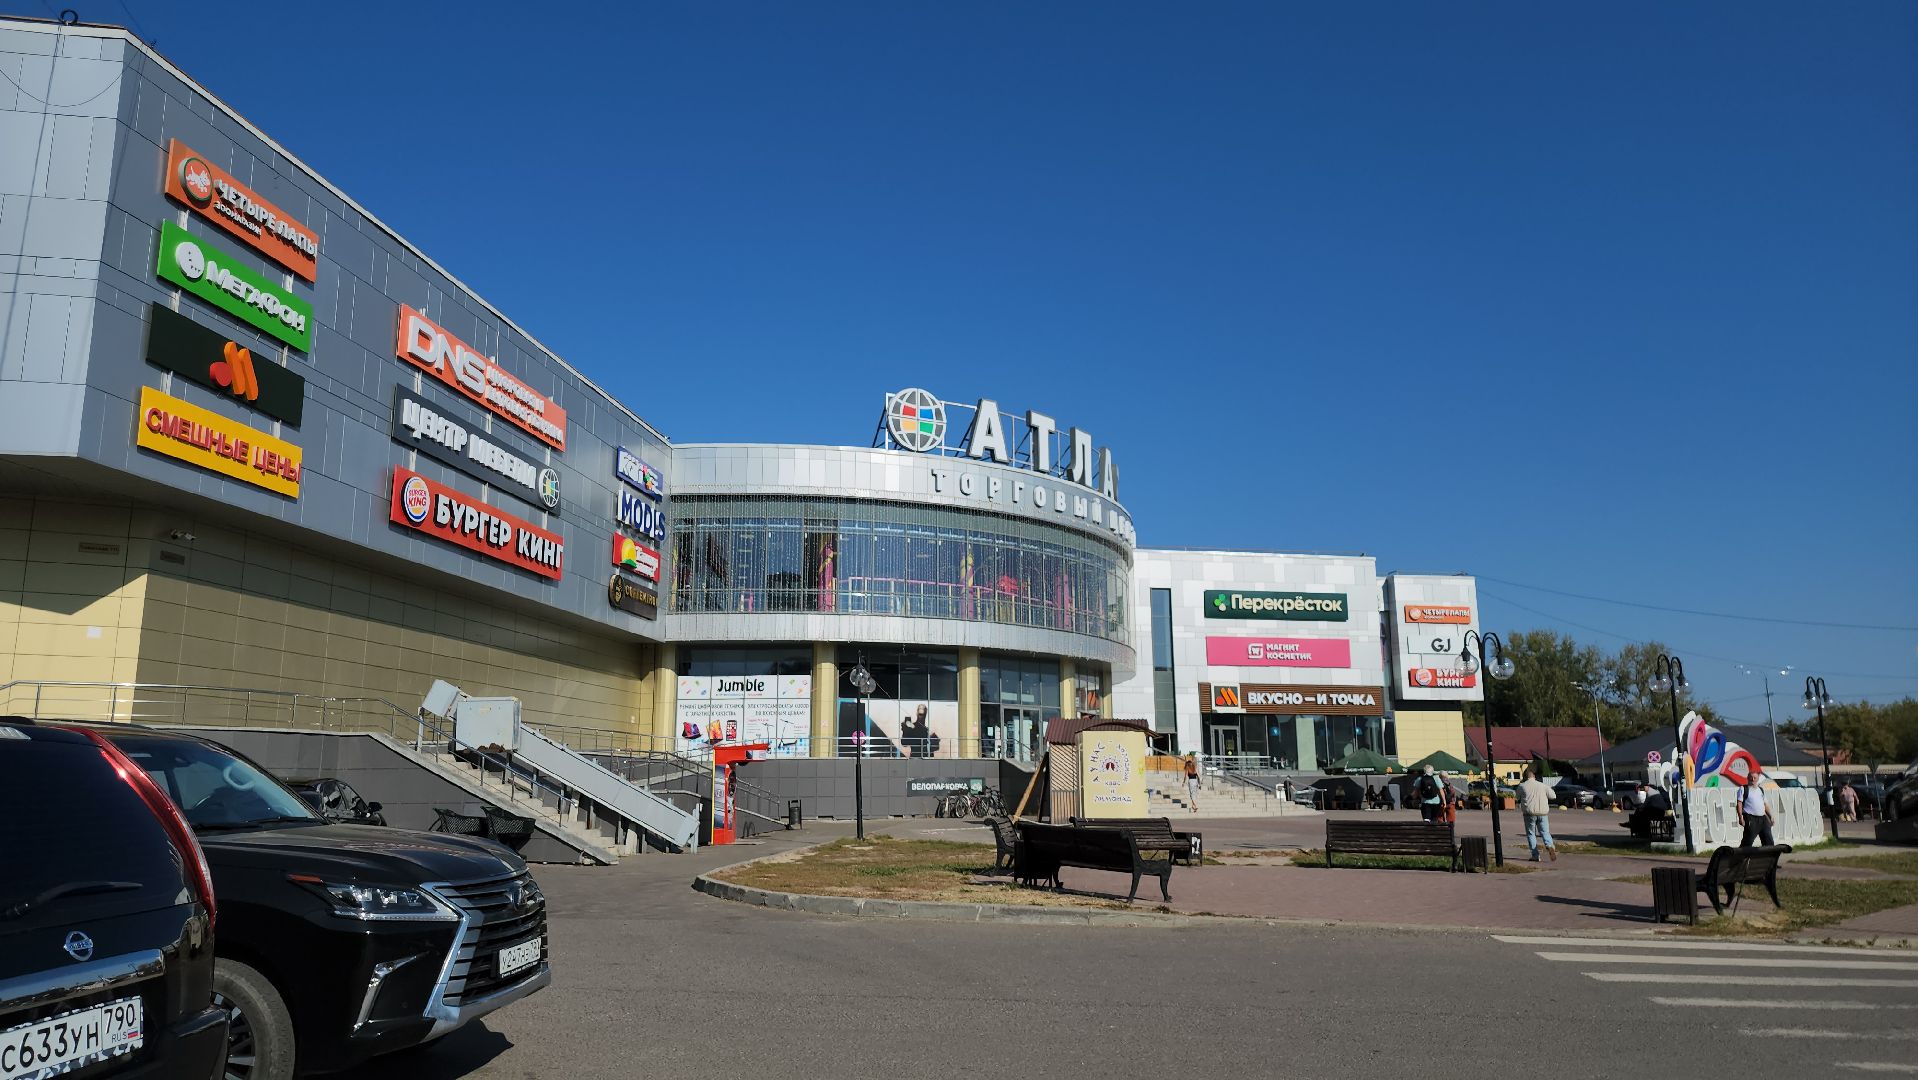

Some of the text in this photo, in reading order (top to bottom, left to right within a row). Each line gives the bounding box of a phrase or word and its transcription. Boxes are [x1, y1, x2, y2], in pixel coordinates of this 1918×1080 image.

[213, 200, 262, 236] ЗООМАГАЗИН
[213, 178, 317, 260] ЧЕТЫРЕ ЛАПЫ
[205, 260, 305, 333] МЕГАФОН
[406, 315, 487, 394] DNS
[145, 407, 300, 484] СМЕШНЫЕ ЦЕНЫ
[402, 398, 537, 490] ЦЕНТР МЕБЕЛИ
[967, 398, 1119, 502] АТЛА
[408, 497, 427, 507] KING
[619, 490, 666, 541] MODIS
[931, 468, 1102, 525] ТОРГОВЫЙ
[436, 493, 564, 569] БУРГЕР КИНГ
[1231, 594, 1343, 614] Перекрёсток
[1266, 643, 1300, 651] МАГНИТ
[1266, 652, 1313, 660] КОСМЕТИК
[1431, 638, 1451, 652] GJ
[717, 679, 765, 692] Jumble
[1248, 692, 1303, 705] ВКУСНО
[1317, 694, 1327, 704] И
[1329, 694, 1376, 705] ТОЧКА
[1437, 677, 1465, 687] КИНГ
[911, 782, 969, 791] ВЕЛОПАРКОВКА
[1689, 788, 1824, 843] #СЕХОВ
[1, 1003, 135, 1074] С633УН 790
[111, 1032, 128, 1044] RUS
